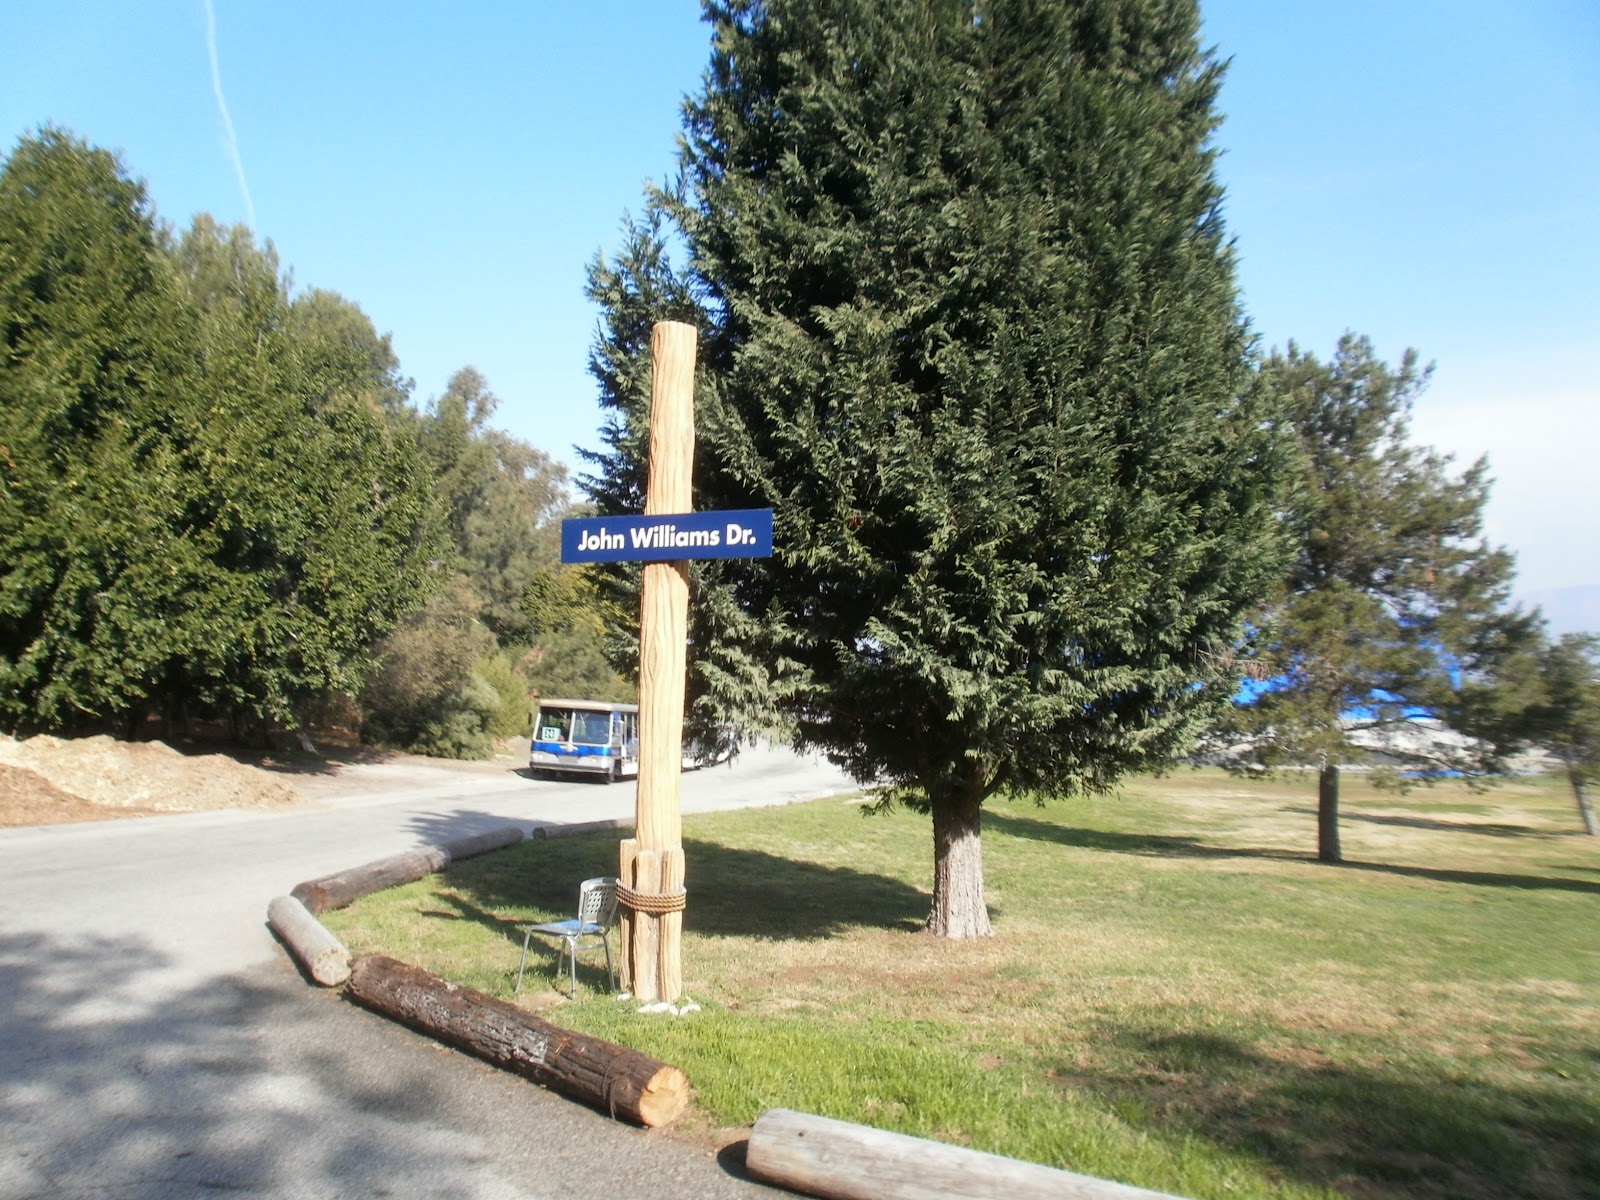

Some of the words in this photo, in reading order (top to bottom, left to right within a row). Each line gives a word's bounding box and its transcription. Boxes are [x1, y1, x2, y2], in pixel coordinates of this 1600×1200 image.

[577, 527, 625, 551] John
[630, 525, 720, 549] Williams
[726, 524, 756, 546] Dr.
